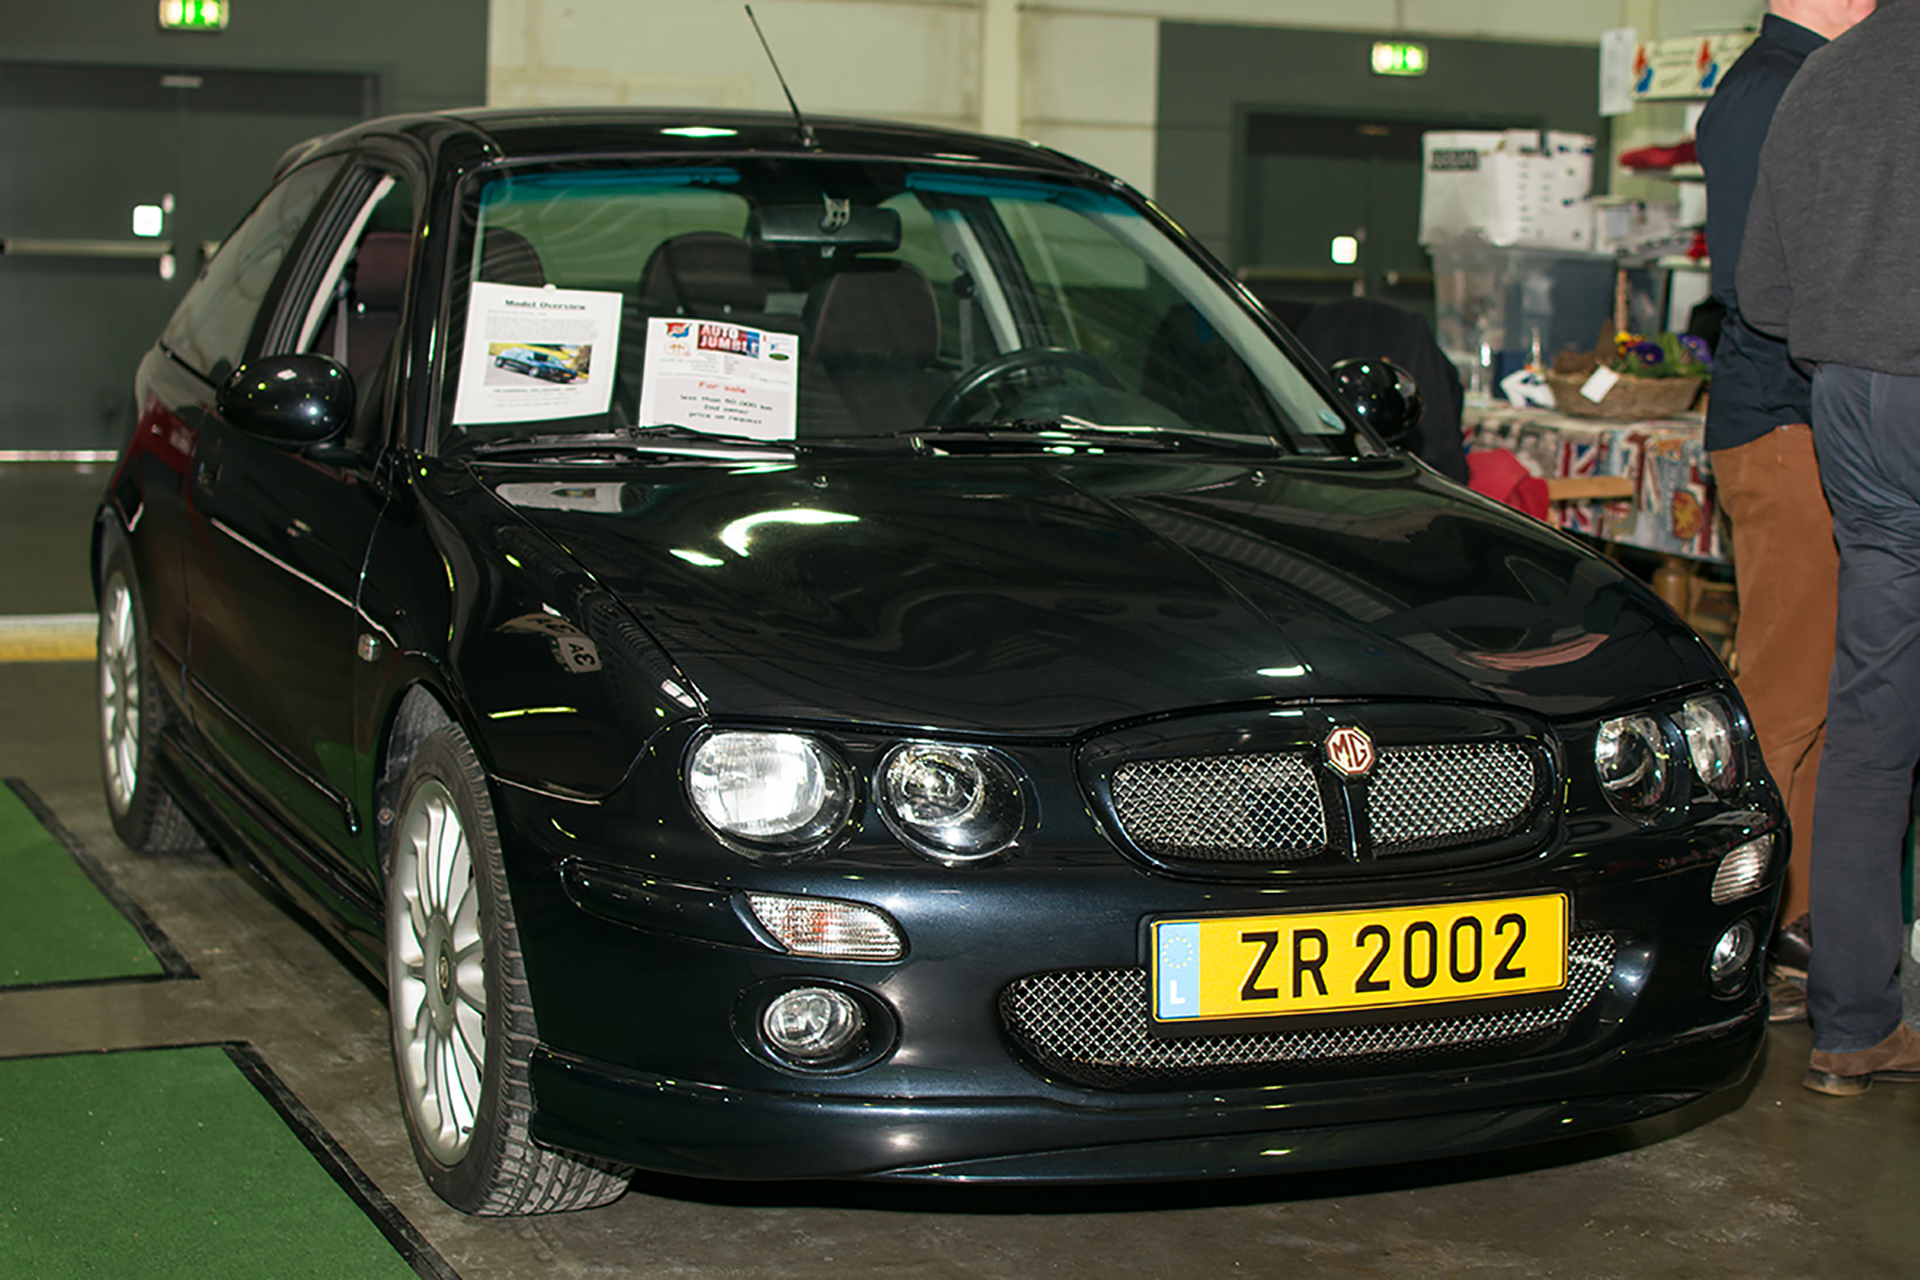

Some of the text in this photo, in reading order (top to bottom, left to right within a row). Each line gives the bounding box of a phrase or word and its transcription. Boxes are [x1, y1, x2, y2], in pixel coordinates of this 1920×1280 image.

[505, 299, 586, 311] Model Overview
[700, 323, 740, 341] AUTO
[699, 335, 760, 355] JUMBLE
[699, 381, 746, 394] For sale
[1331, 732, 1368, 769] MG
[1240, 912, 1528, 1002] ZR 2002
[1169, 979, 1187, 1005] L
